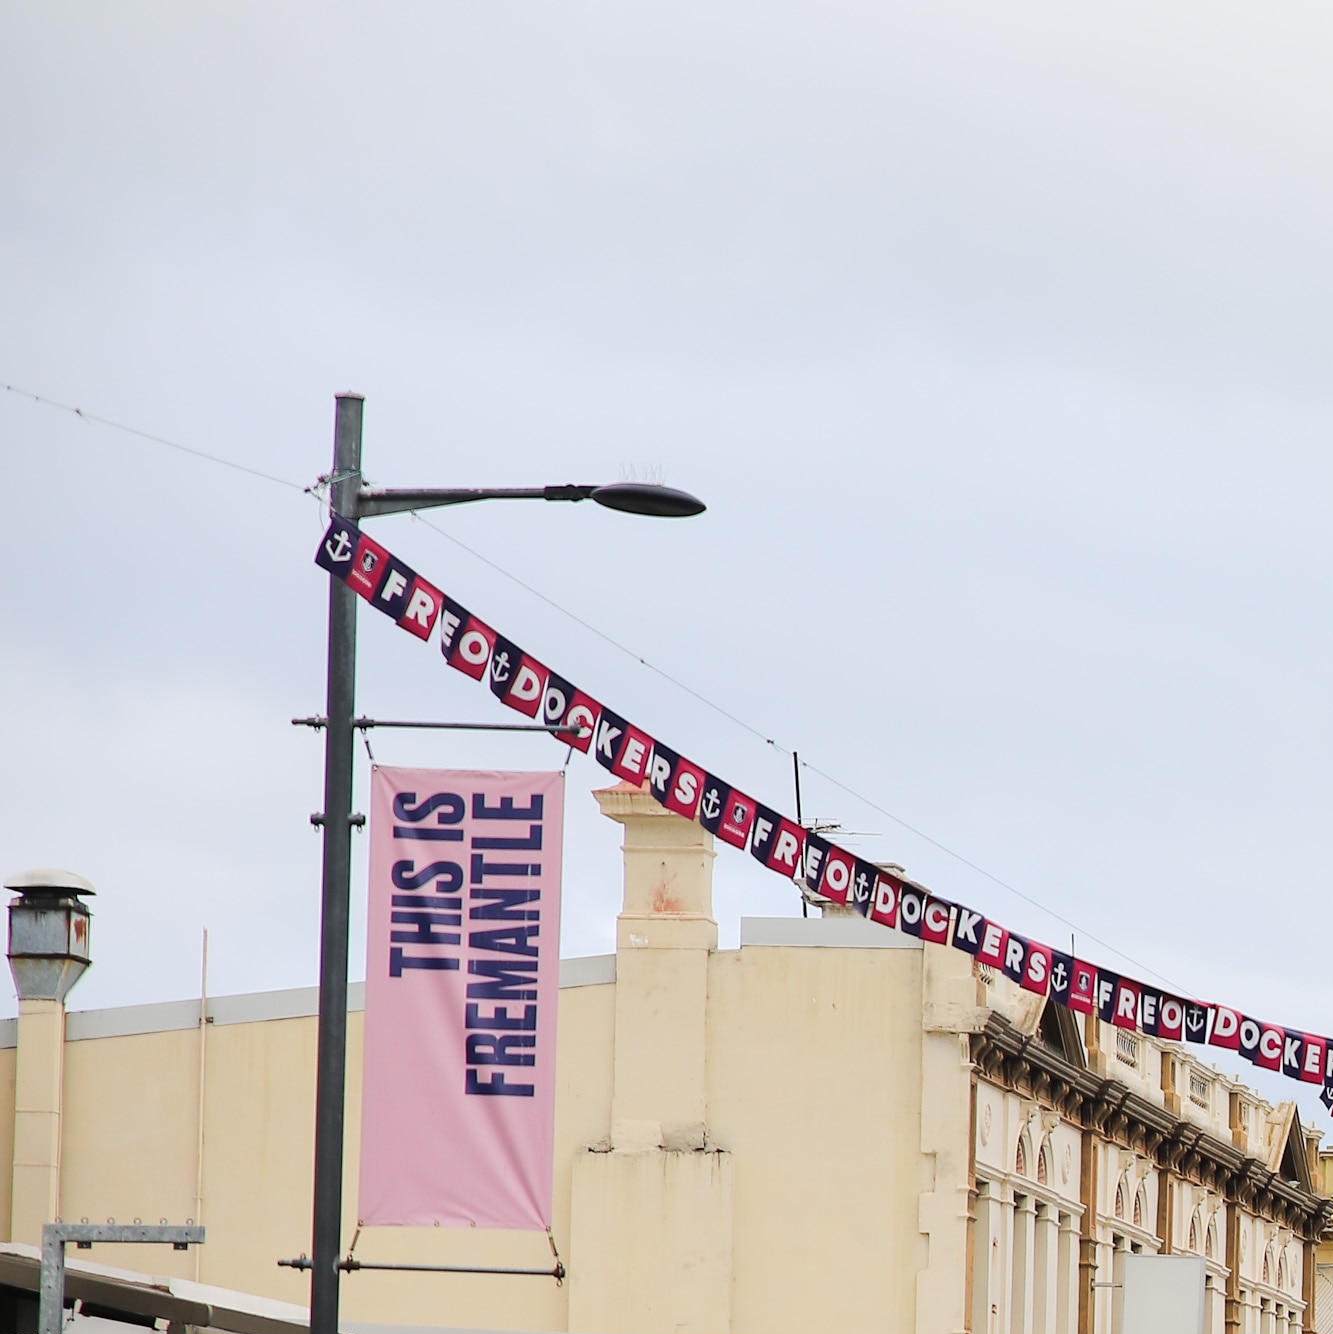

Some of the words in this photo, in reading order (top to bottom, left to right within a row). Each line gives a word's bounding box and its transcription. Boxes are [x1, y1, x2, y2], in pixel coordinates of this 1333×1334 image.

[381, 567, 491, 665] FREO
[510, 666, 698, 805] DOCKERS
[752, 820, 850, 892] FREO
[875, 884, 1047, 982] DOCKERS
[1098, 979, 1184, 1031] FREO
[392, 790, 467, 842] IS
[389, 860, 465, 977] THIS
[464, 791, 545, 1097] FREMANTLE
